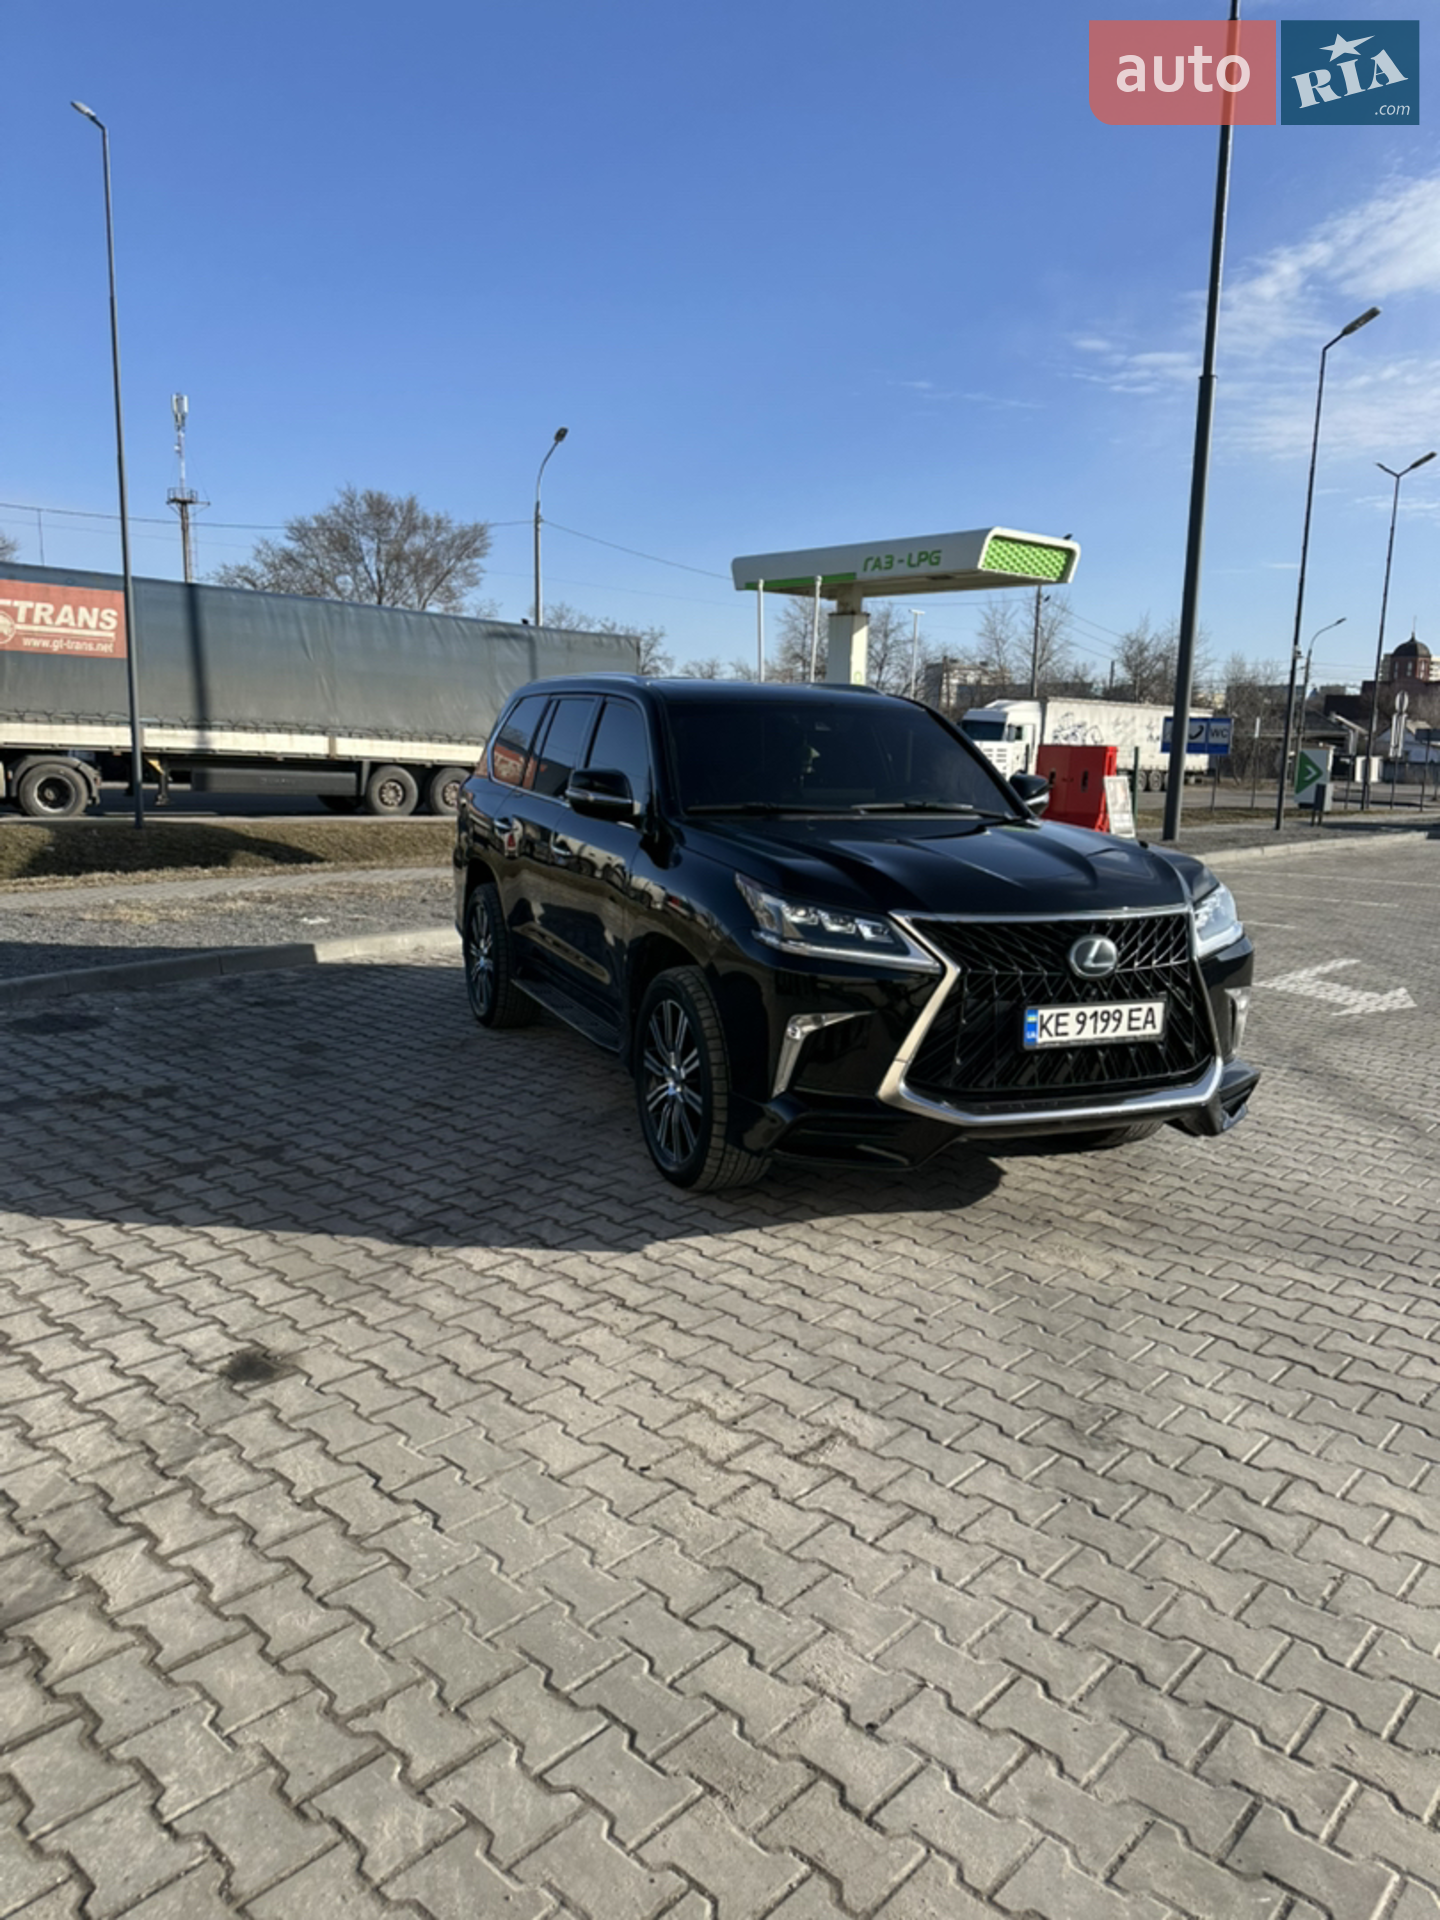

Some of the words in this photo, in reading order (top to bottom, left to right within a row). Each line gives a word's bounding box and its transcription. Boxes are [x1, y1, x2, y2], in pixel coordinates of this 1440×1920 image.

[1211, 728, 1228, 738] WC
[1039, 1012, 1070, 1038] KE
[1075, 1009, 1123, 1035] 9199
[1127, 1007, 1157, 1032] EA
